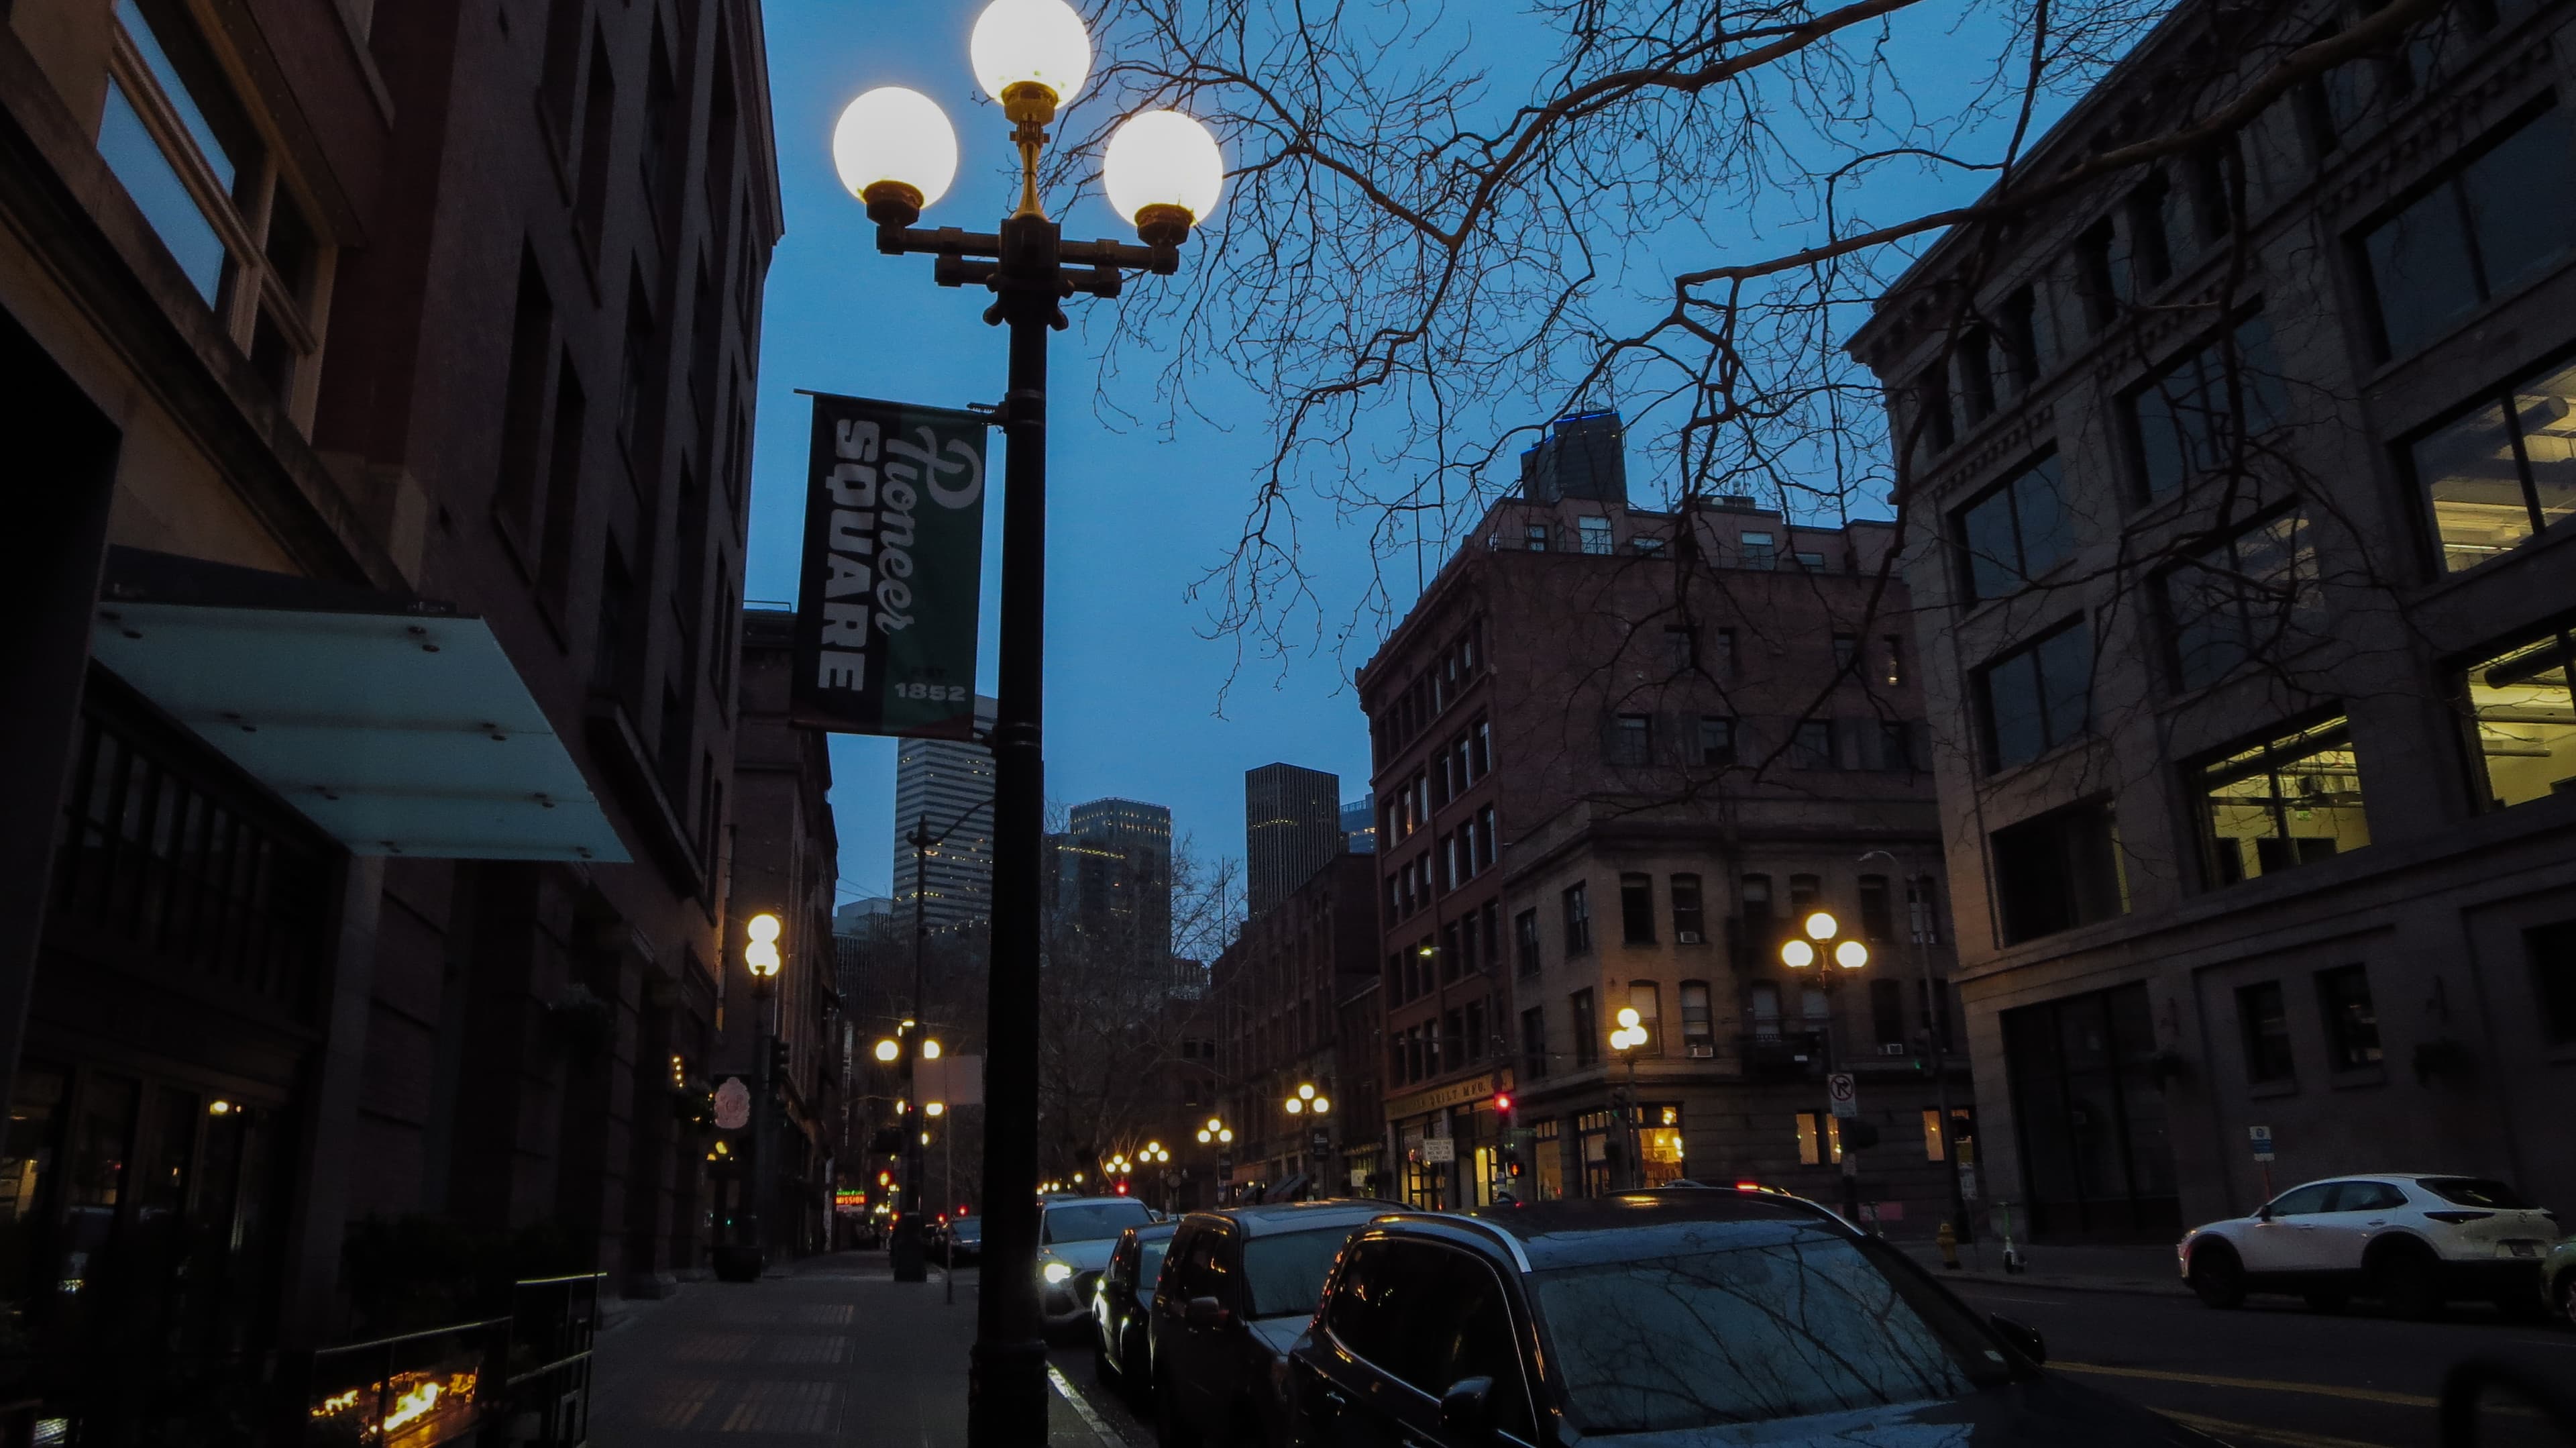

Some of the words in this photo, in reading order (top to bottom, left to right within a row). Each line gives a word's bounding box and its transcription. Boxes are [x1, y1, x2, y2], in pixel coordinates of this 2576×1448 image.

[818, 419, 880, 692] SQUARE
[875, 425, 983, 635] Pioneer
[895, 682, 967, 702] 1852
[836, 1196, 865, 1204] MISSION
